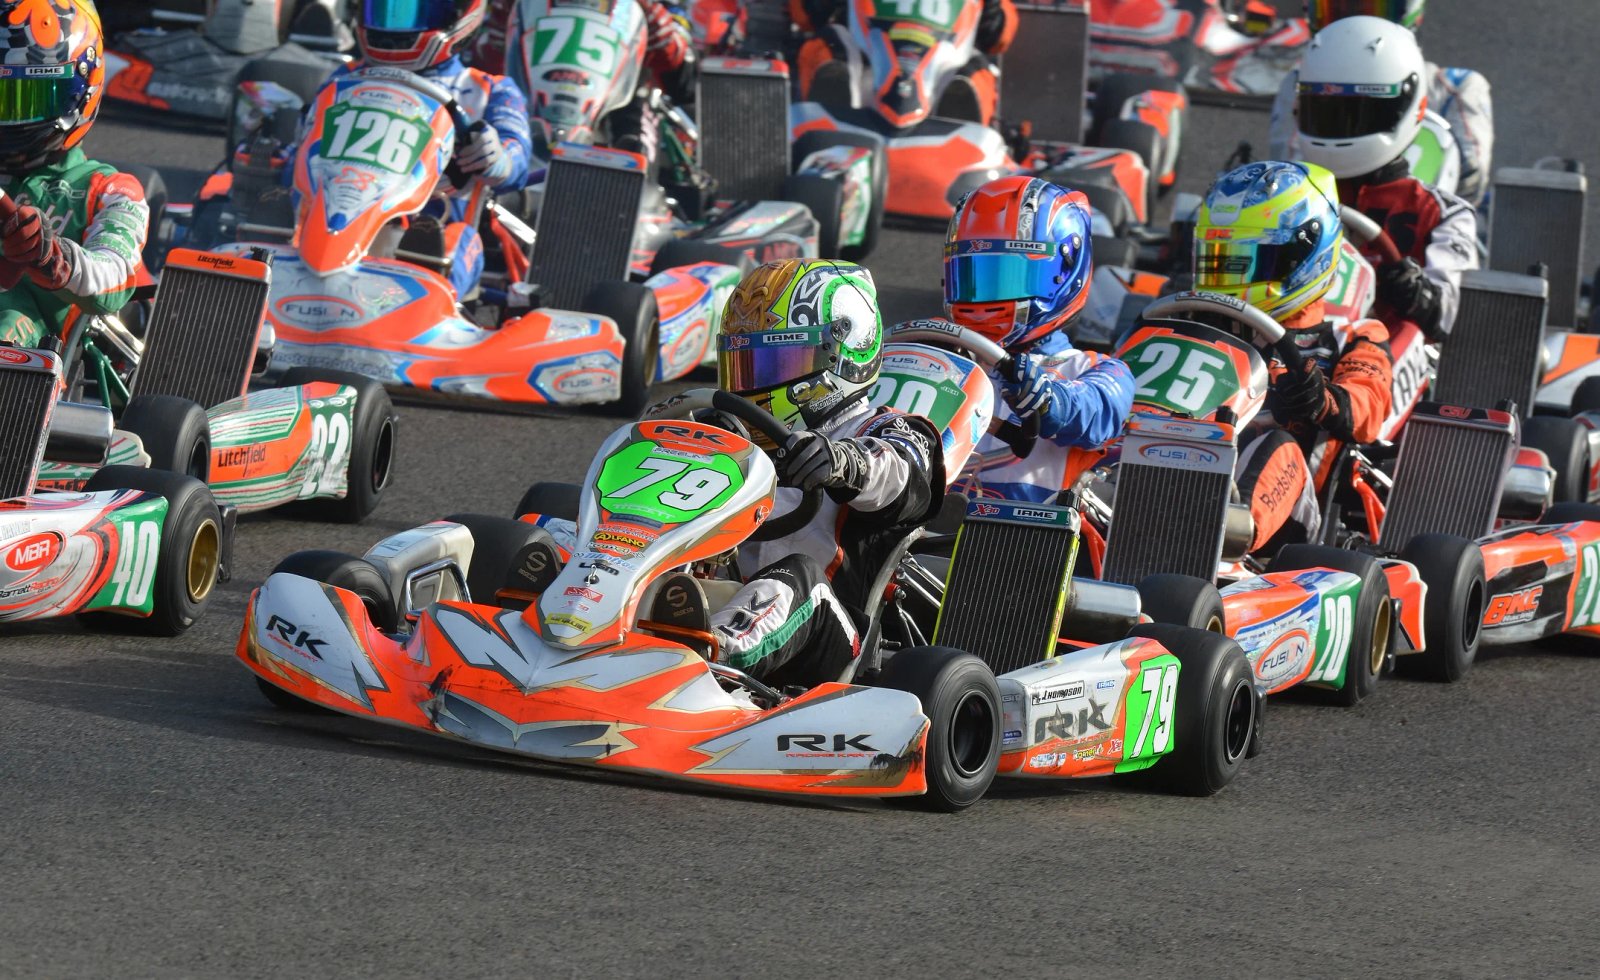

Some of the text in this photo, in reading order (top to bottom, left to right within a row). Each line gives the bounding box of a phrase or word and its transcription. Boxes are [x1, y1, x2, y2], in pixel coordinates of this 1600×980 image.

[536, 17, 619, 74] 75
[326, 109, 420, 175] 126
[967, 240, 1043, 253] X30 IAME
[285, 303, 356, 318] FUSION
[728, 334, 805, 350] X30 IAME
[894, 321, 961, 334] EXPRIT
[1134, 342, 1226, 411] 25
[654, 425, 731, 447] RK
[217, 445, 266, 478] Litchfield
[1147, 448, 1213, 462] FUSION
[603, 457, 732, 512] 79
[1259, 459, 1300, 513] Bradshaw
[970, 503, 1054, 519] X30 IAME
[14, 539, 50, 566] MBR
[594, 532, 646, 548] ALFANO
[111, 521, 159, 606] 40
[1571, 543, 1600, 628] 2
[265, 614, 330, 661] RK
[1304, 595, 1352, 681] 20
[1261, 642, 1305, 672] FUSION
[1034, 698, 1112, 744] RK
[1129, 664, 1178, 759] 79
[777, 734, 880, 752] RK
